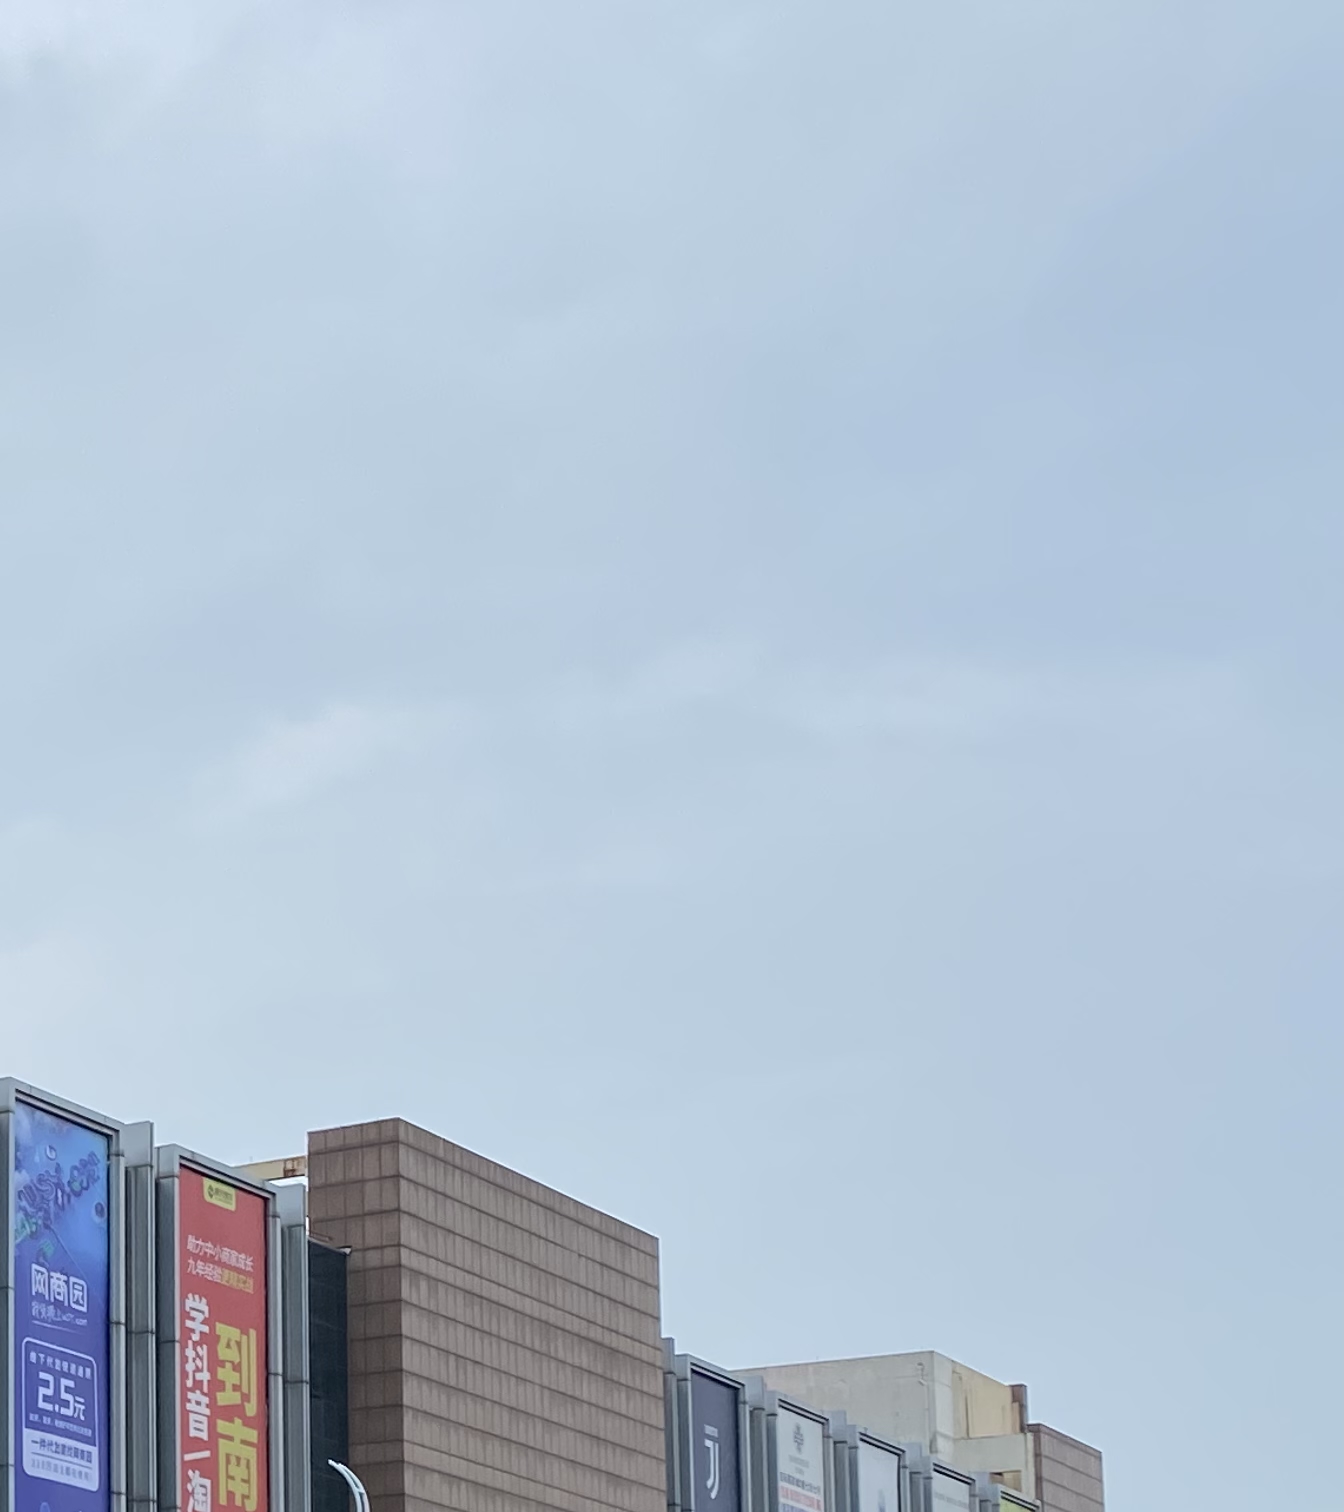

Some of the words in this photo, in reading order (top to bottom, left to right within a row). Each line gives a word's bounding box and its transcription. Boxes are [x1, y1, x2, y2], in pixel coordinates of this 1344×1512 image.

[31, 1263, 88, 1313] 网商园
[37, 1371, 86, 1421] 2.5元
